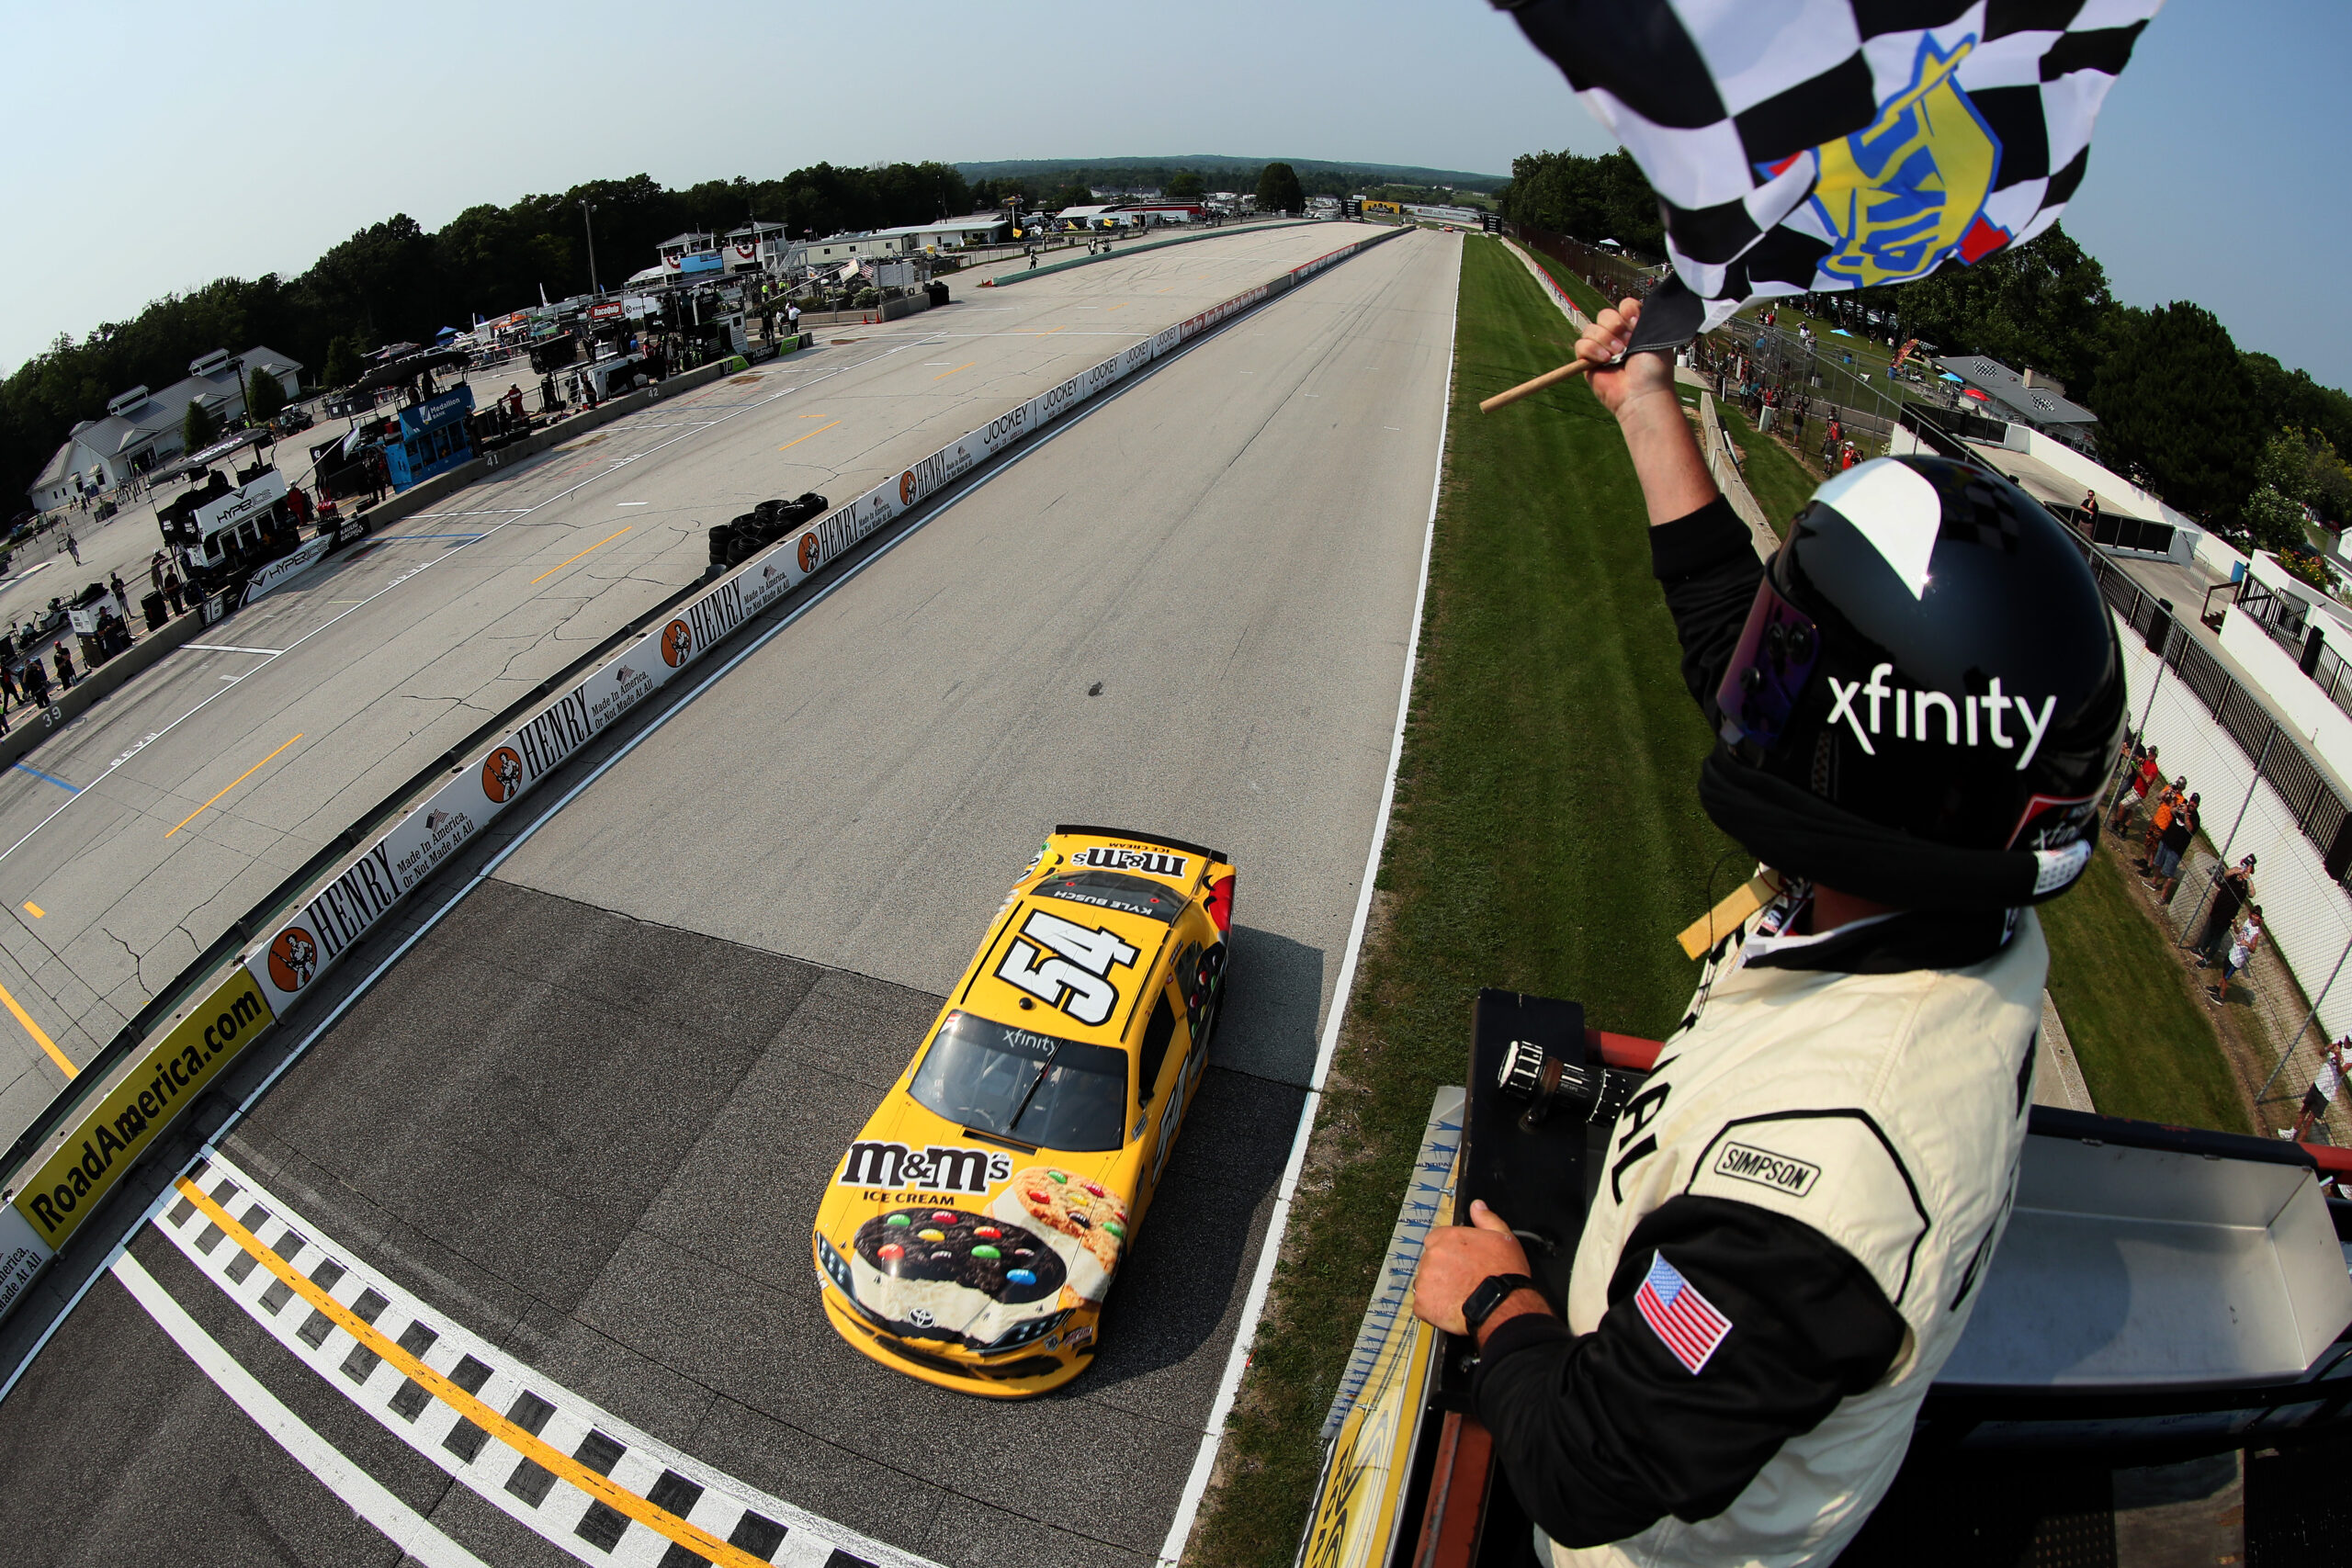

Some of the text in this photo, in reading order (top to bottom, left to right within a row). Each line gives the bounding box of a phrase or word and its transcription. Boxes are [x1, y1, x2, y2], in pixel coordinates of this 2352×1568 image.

[594, 304, 620, 316] RaceQuip
[1126, 341, 1149, 364] JOCKEY
[1157, 326, 1176, 346] JOCKEY
[1090, 357, 1117, 384] JOCKEY
[431, 398, 460, 413] Medallion
[649, 388, 659, 399] 42
[1044, 378, 1078, 411] JOCKEY
[984, 404, 1028, 444] JOCKEY
[487, 455, 498, 467] 41
[916, 449, 947, 498] HENRY
[217, 489, 272, 523] HYPERICE
[819, 502, 858, 563] HENRY
[269, 539, 330, 579] HYPERICE
[203, 595, 223, 626] 16
[688, 576, 745, 653] HENRY
[591, 671, 649, 716] Made In America,
[594, 679, 653, 729] Or Not Made At All
[42, 705, 62, 728] 39
[515, 685, 594, 781] HENRY
[1827, 663, 2057, 771] xfinity
[397, 812, 469, 875] Made In America,
[402, 819, 475, 888] Or Not Made At All
[1109, 841, 1170, 854] ICE CREAM
[304, 840, 403, 960] HENRY
[1055, 890, 1153, 915] KYLE BUSCH
[992, 908, 1142, 1027] 54
[1002, 1029, 1056, 1056] xfinity
[29, 991, 263, 1233] RoadAmerica.com
[1722, 1148, 1810, 1190] SIMPSON
[863, 1190, 956, 1206] ICE CREAM
[0, 1247, 29, 1285] merica,
[16, 1269, 30, 1284] At
[26, 1251, 42, 1272] All
